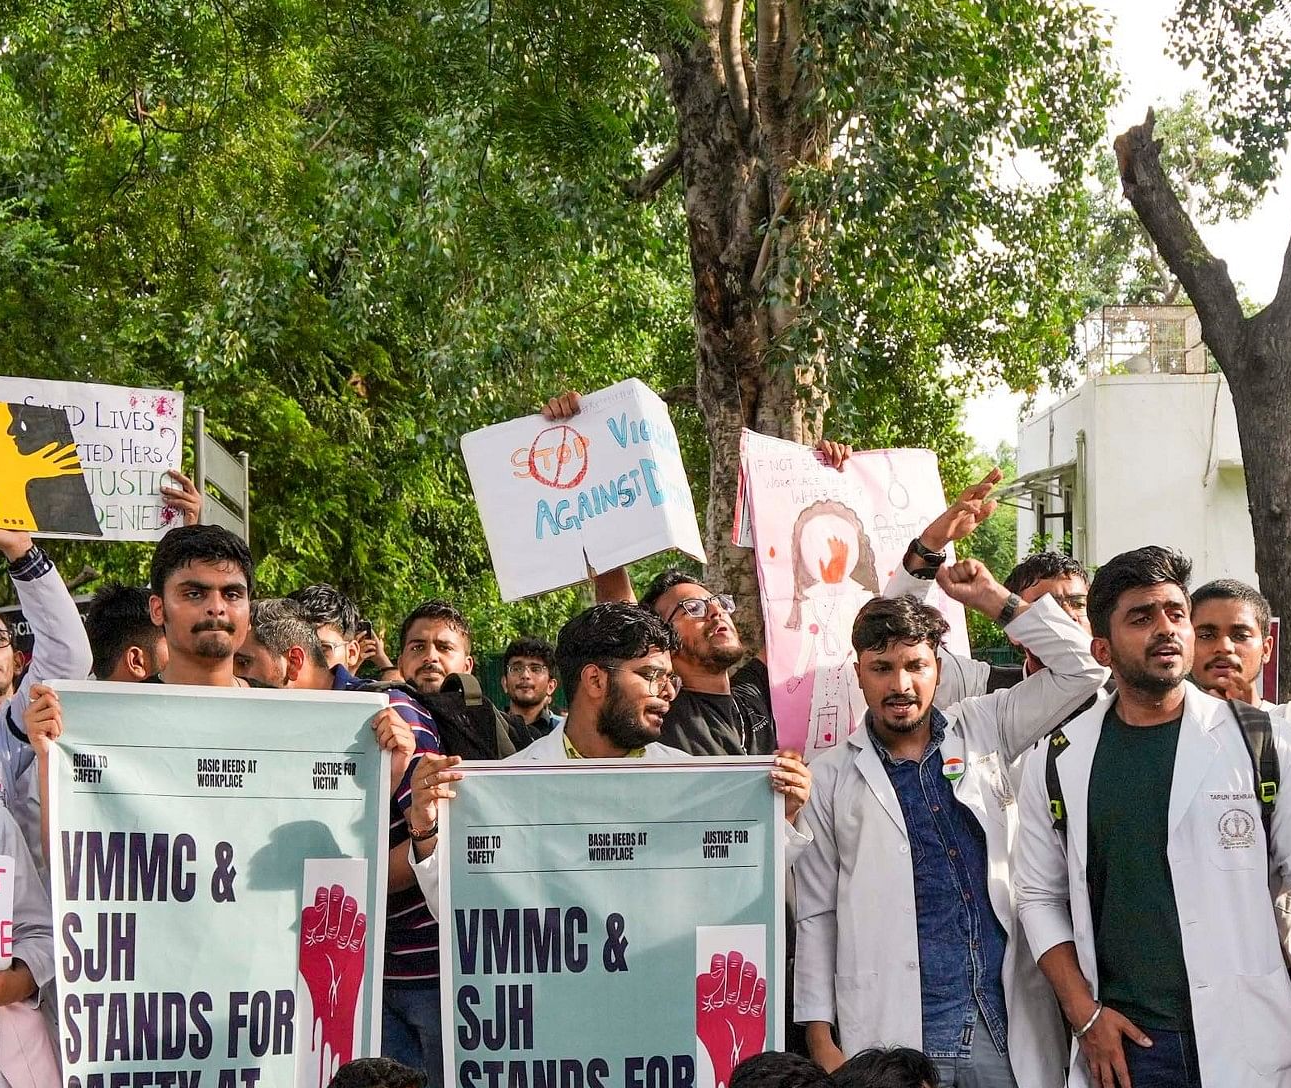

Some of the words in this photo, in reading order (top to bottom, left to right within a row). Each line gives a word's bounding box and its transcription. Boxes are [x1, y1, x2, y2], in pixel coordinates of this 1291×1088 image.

[95, 401, 154, 432] LIVES
[511, 436, 590, 479] STOP
[535, 468, 642, 539] AGAINST
[73, 753, 96, 769] RIGHT
[98, 754, 108, 768] TO
[197, 758, 220, 773] BASIC
[221, 759, 246, 774] NEEDS
[248, 759, 257, 774] AT
[312, 761, 342, 776] JUSTICE
[344, 762, 357, 776] FOR
[73, 768, 102, 784] SAFETY
[197, 773, 243, 788] WORKPLACE
[312, 776, 339, 790] VICTIM
[467, 836, 489, 850] RIGHT
[490, 835, 501, 849] TO
[588, 833, 610, 847] BASIC
[612, 833, 636, 847] NEEDS
[638, 832, 648, 846] AT
[702, 830, 733, 844] JUSTICE
[734, 830, 749, 844] FOR
[467, 850, 495, 865] SAFETY
[588, 847, 634, 862] WORKPLACE
[702, 845, 729, 859] VICTIM
[61, 831, 197, 902] VMMC
[210, 841, 237, 903] &
[61, 912, 137, 983] SJH
[455, 906, 589, 975] VMMC
[602, 912, 629, 972] &
[457, 984, 533, 1051] SJH
[64, 991, 212, 1065] STANDS
[227, 989, 296, 1059] FOR
